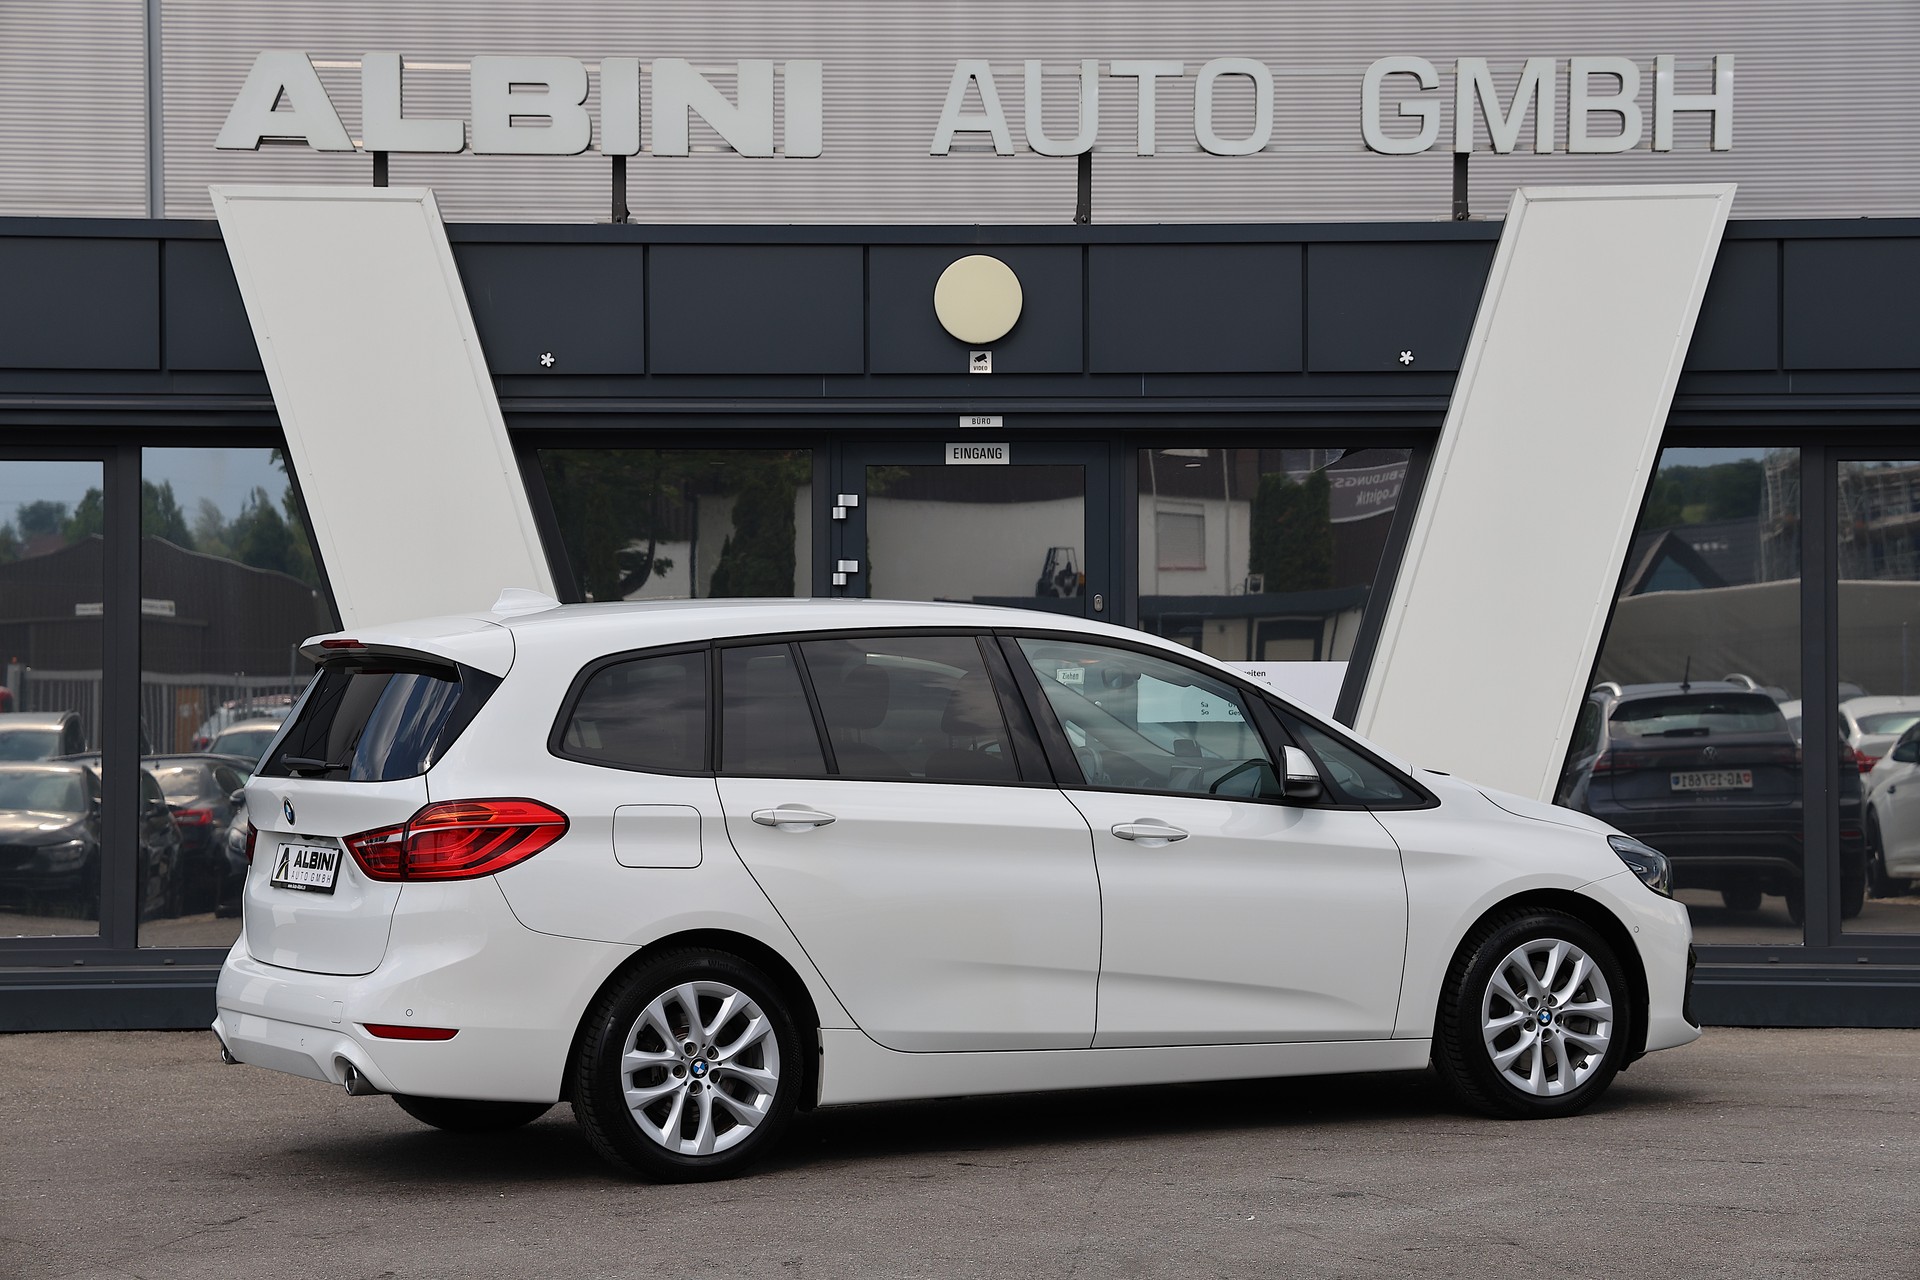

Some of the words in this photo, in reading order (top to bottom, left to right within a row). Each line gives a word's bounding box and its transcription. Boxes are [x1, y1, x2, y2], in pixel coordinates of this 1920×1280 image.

[214, 50, 823, 158] ALBINI
[929, 56, 1275, 157] AUTO
[1360, 54, 1736, 155] GMBH
[971, 417, 992, 425] BÜRO
[953, 447, 1003, 460] EINGANG
[1244, 669, 1266, 677] eiten
[293, 850, 336, 871] ALBINI
[291, 870, 309, 881] AUTO
[310, 872, 332, 884] GMBH
